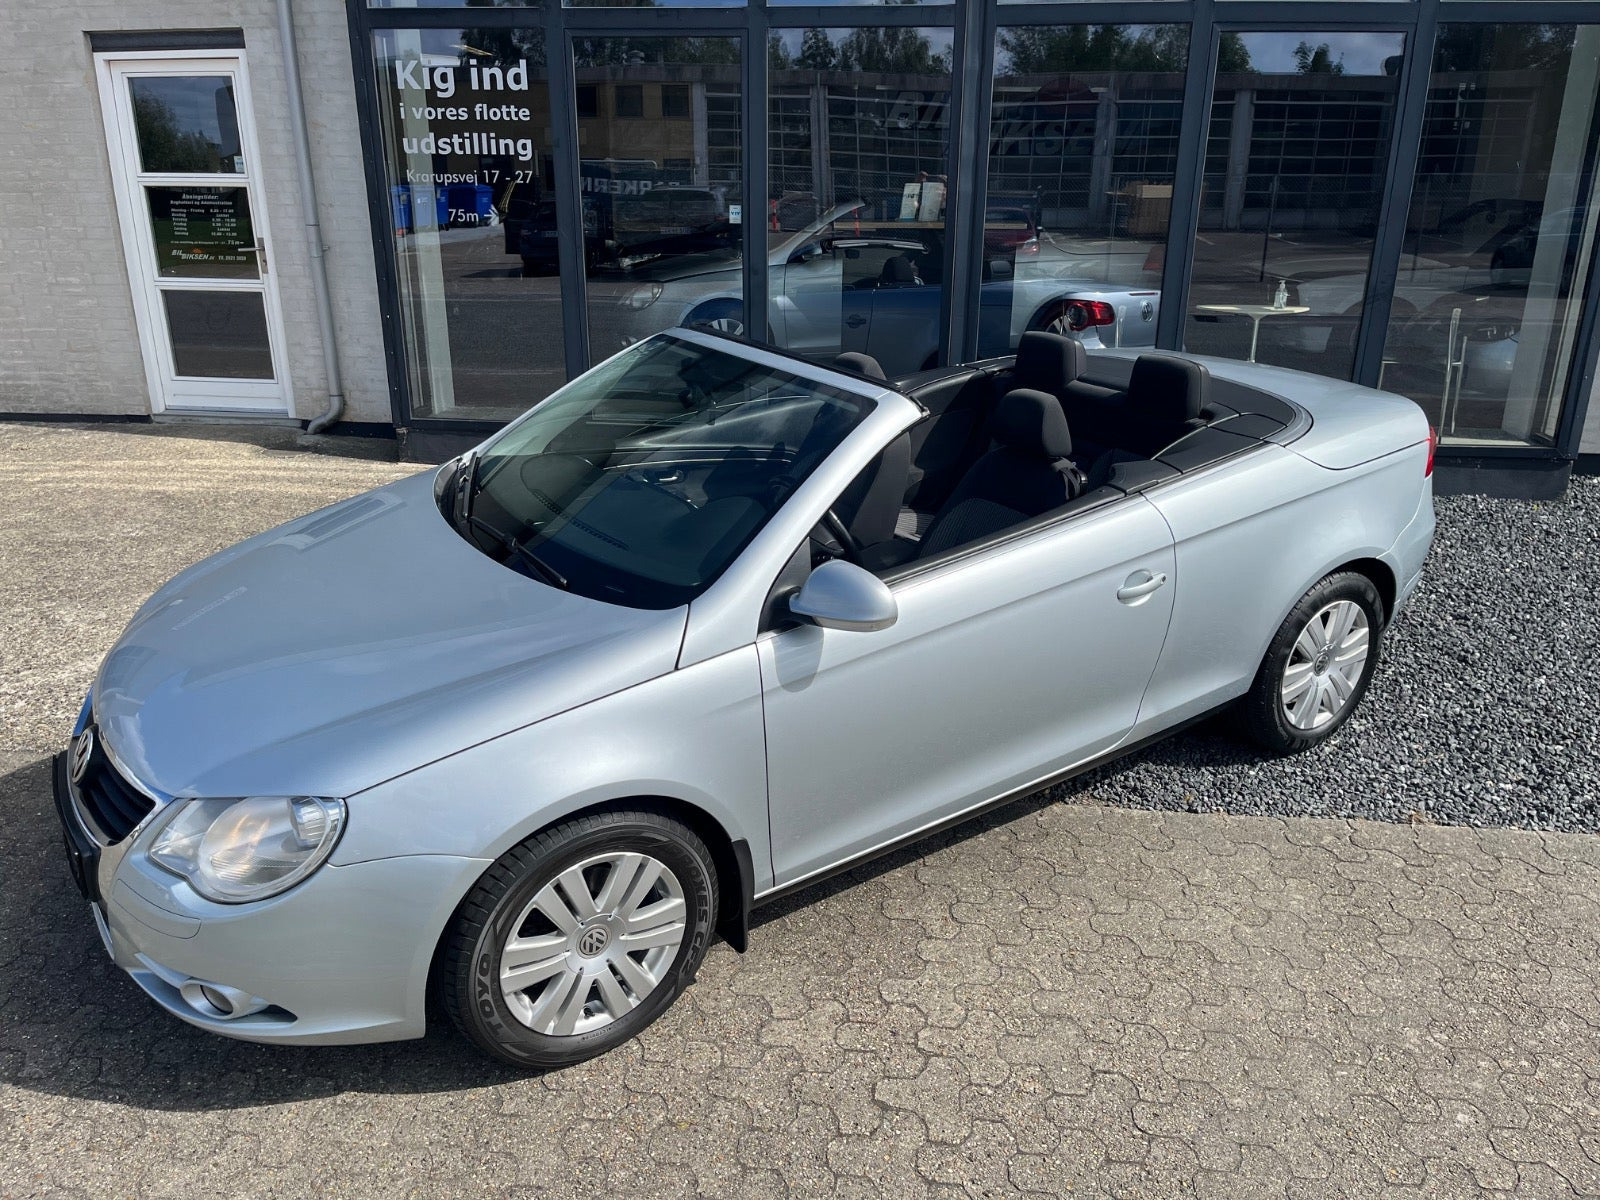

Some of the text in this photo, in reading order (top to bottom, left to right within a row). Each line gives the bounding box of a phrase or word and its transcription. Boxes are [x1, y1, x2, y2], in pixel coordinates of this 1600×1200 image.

[395, 59, 529, 98] Kig ind
[399, 102, 531, 121] i vores flotte
[402, 132, 533, 161] udstilling
[406, 169, 479, 186] Krarupsvej
[483, 170, 500, 184] 17
[515, 170, 533, 184] 27
[448, 208, 479, 223] 75m
[477, 953, 503, 1037] TOYO
